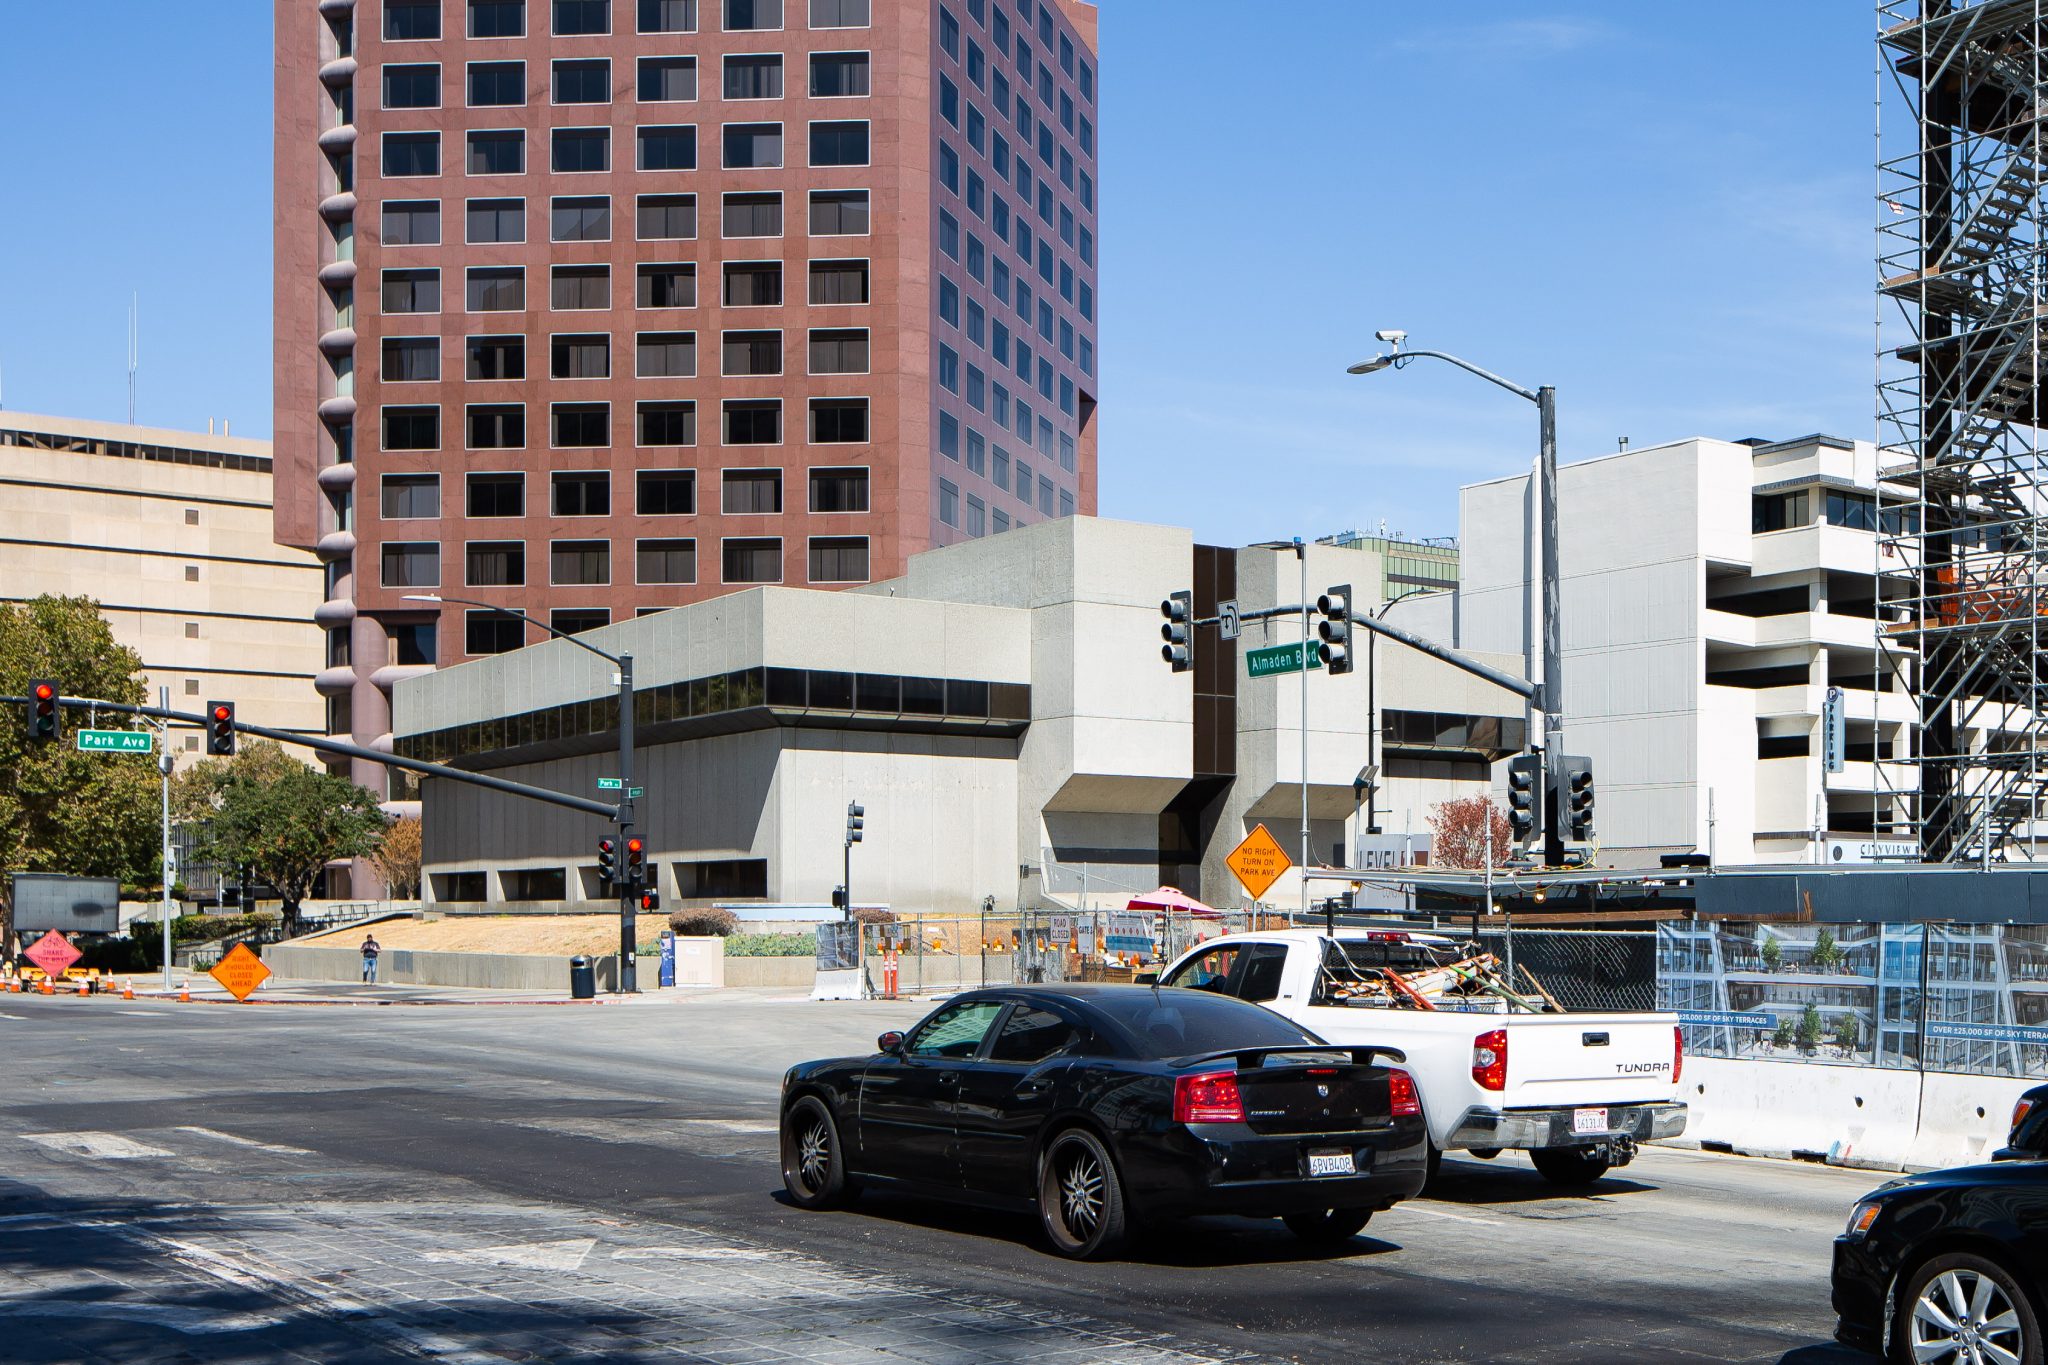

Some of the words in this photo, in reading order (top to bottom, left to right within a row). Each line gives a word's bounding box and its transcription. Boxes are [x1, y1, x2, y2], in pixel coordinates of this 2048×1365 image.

[1252, 653, 1292, 671] Almaden
[1295, 648, 1317, 664] Bvd
[85, 734, 114, 746] Park
[123, 736, 145, 747] Ave
[1255, 848, 1276, 856] RIGHT
[1860, 844, 1911, 855] CITYVIEW
[1053, 918, 1066, 928] ROAD
[1052, 929, 1069, 939] CLOSED
[1079, 926, 1089, 934] GATE
[1735, 1016, 1767, 1025] TERRACES
[1933, 1026, 1952, 1034] OVER
[1954, 1027, 1983, 1036] ±25,000
[1995, 1029, 2005, 1037] OF
[2007, 1030, 2021, 1038] SKY
[1616, 1063, 1670, 1073] TUNDRA
